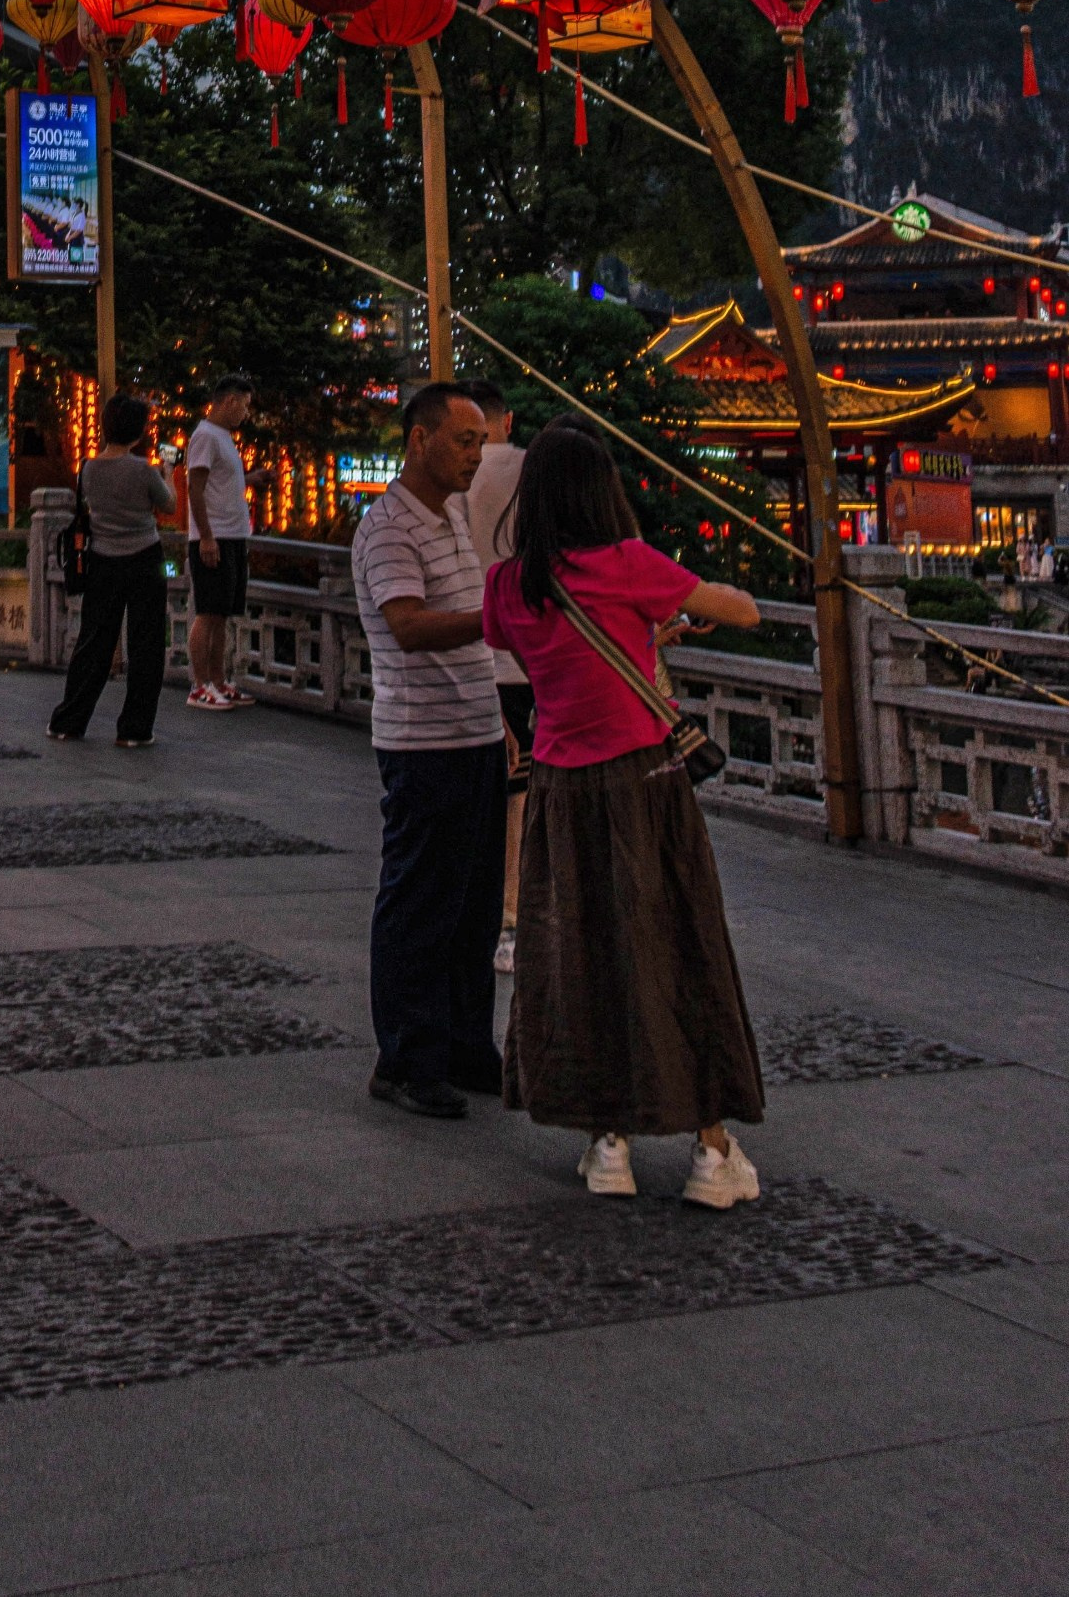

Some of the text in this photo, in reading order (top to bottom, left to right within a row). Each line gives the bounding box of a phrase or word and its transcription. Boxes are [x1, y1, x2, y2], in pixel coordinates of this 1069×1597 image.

[28, 127, 62, 146] 5000
[28, 147, 77, 162] 24小时营业
[32, 175, 48, 188] 免费
